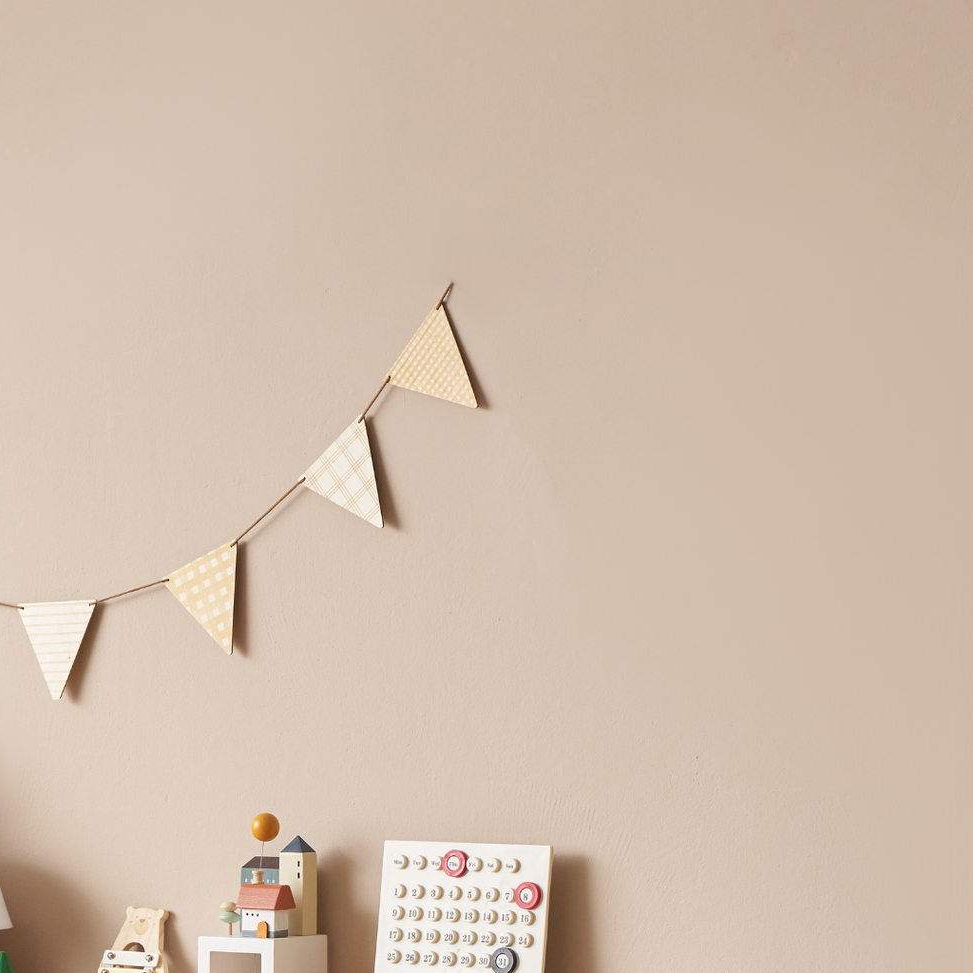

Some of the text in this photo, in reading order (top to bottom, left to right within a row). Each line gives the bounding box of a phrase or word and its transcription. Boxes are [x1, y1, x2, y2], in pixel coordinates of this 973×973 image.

[523, 893, 528, 901] 8
[445, 911, 454, 920] 12
[464, 912, 473, 920] 13
[483, 913, 491, 921] 14
[501, 913, 510, 922] 15
[520, 914, 529, 923] 16
[389, 931, 397, 939] 17
[426, 932, 434, 941] 19
[444, 933, 453, 941] 20
[481, 935, 490, 943] 22
[500, 936, 509, 944] 23
[518, 936, 527, 945] 24
[405, 954, 414, 962] 26
[461, 956, 470, 964] 29
[478, 957, 488, 965] 30
[498, 958, 507, 966] 31
